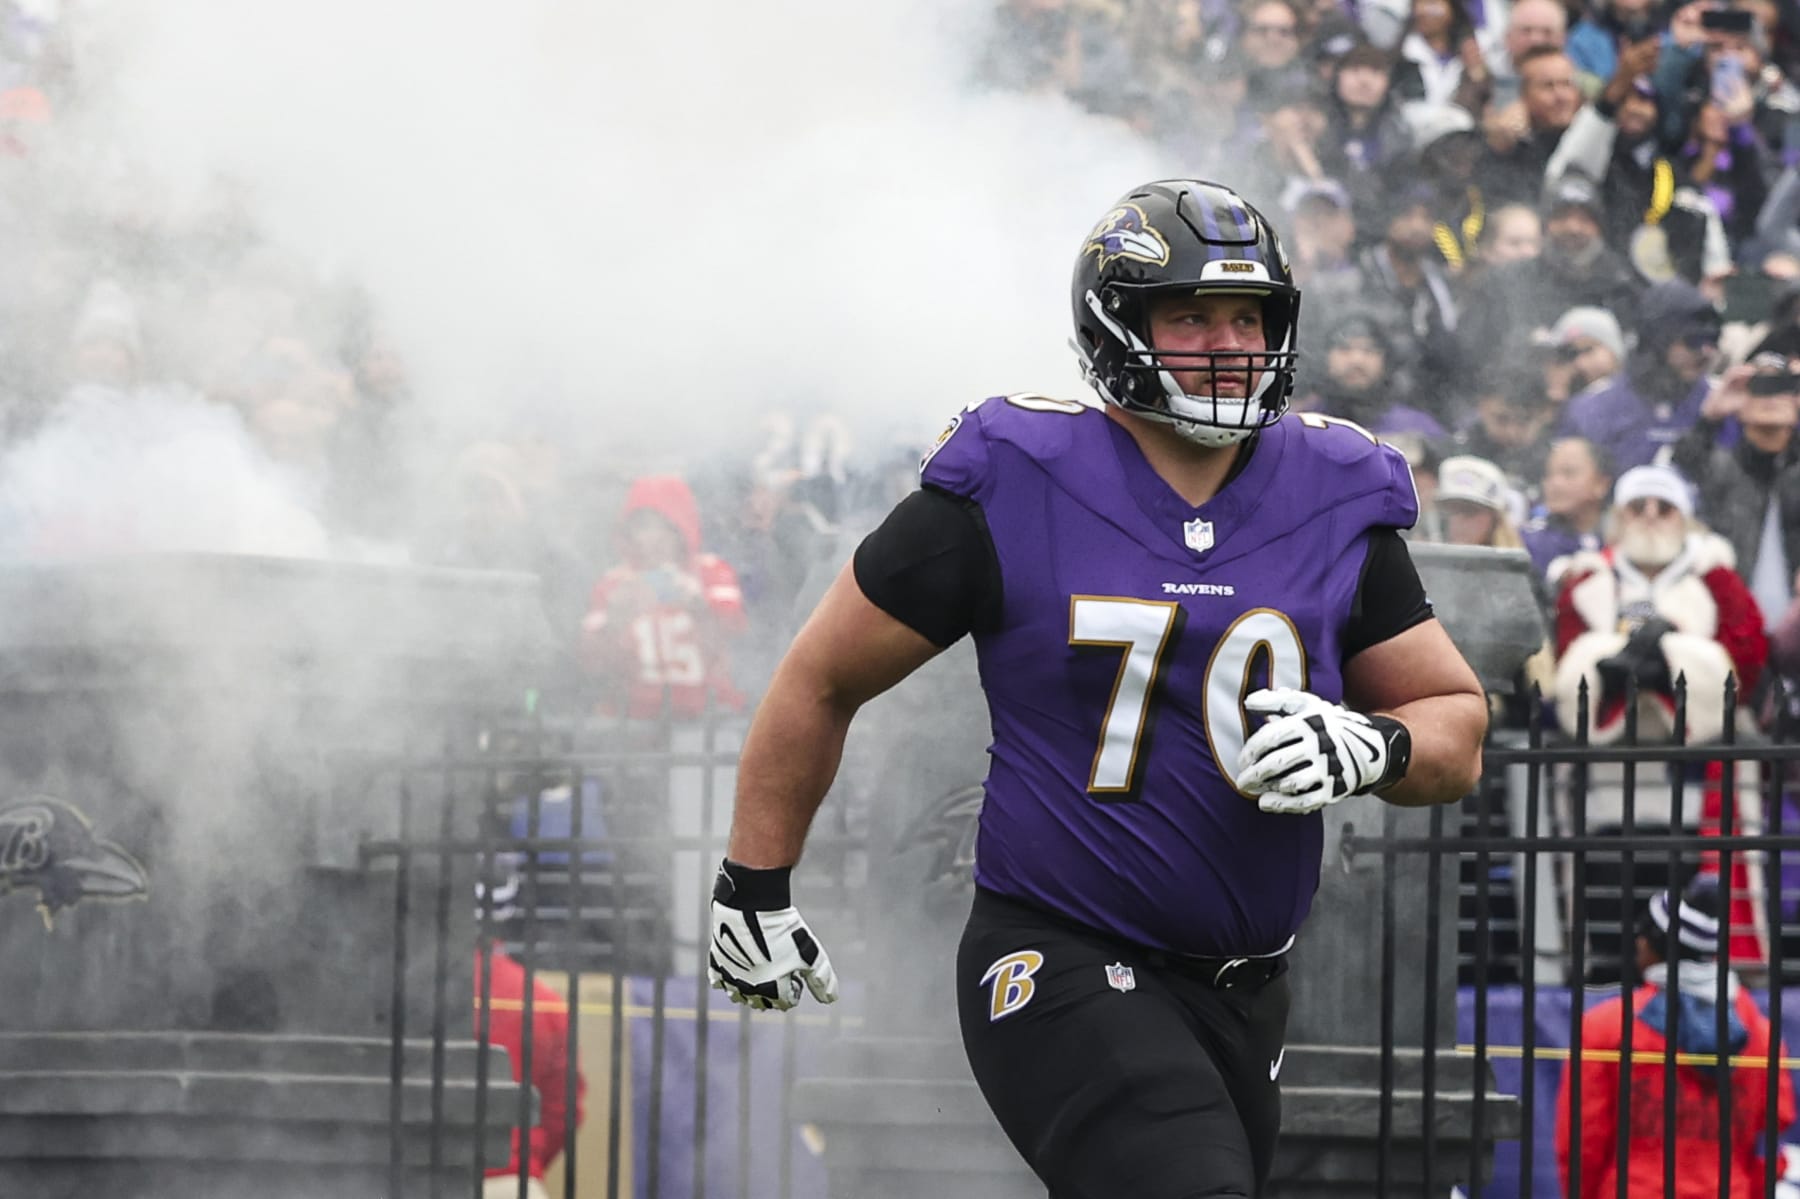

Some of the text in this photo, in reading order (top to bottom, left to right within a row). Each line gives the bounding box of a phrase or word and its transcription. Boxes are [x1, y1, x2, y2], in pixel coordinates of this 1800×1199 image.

[1161, 582, 1235, 596] RAVENS
[632, 611, 704, 686] 15
[1068, 594, 1307, 799] 70
[979, 950, 1044, 1022] B
